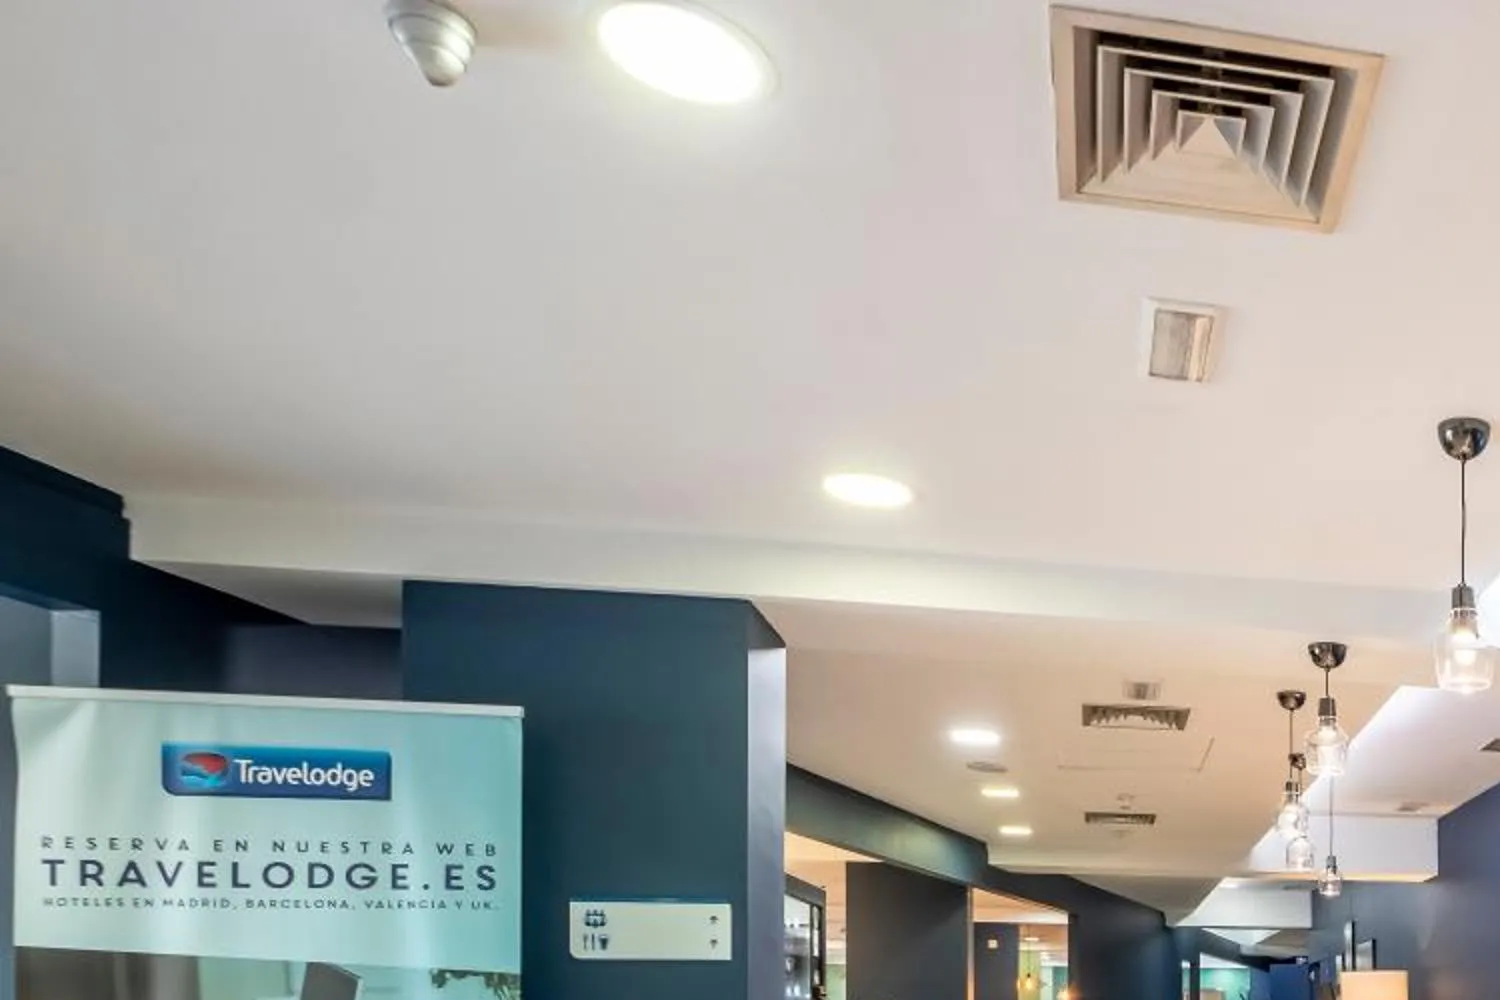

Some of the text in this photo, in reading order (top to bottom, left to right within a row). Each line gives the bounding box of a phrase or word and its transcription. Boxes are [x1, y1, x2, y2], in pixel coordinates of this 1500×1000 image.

[233, 758, 375, 792] Travelodge
[41, 836, 498, 857] RESERVA EN NUESTRA WEB
[42, 858, 498, 891] TRAVELODGE.ES
[43, 896, 126, 909] HOTELES
[132, 897, 156, 909] EN
[162, 897, 239, 912] MADRID,
[364, 899, 448, 911] VALENCIA
[455, 900, 464, 910] Y
